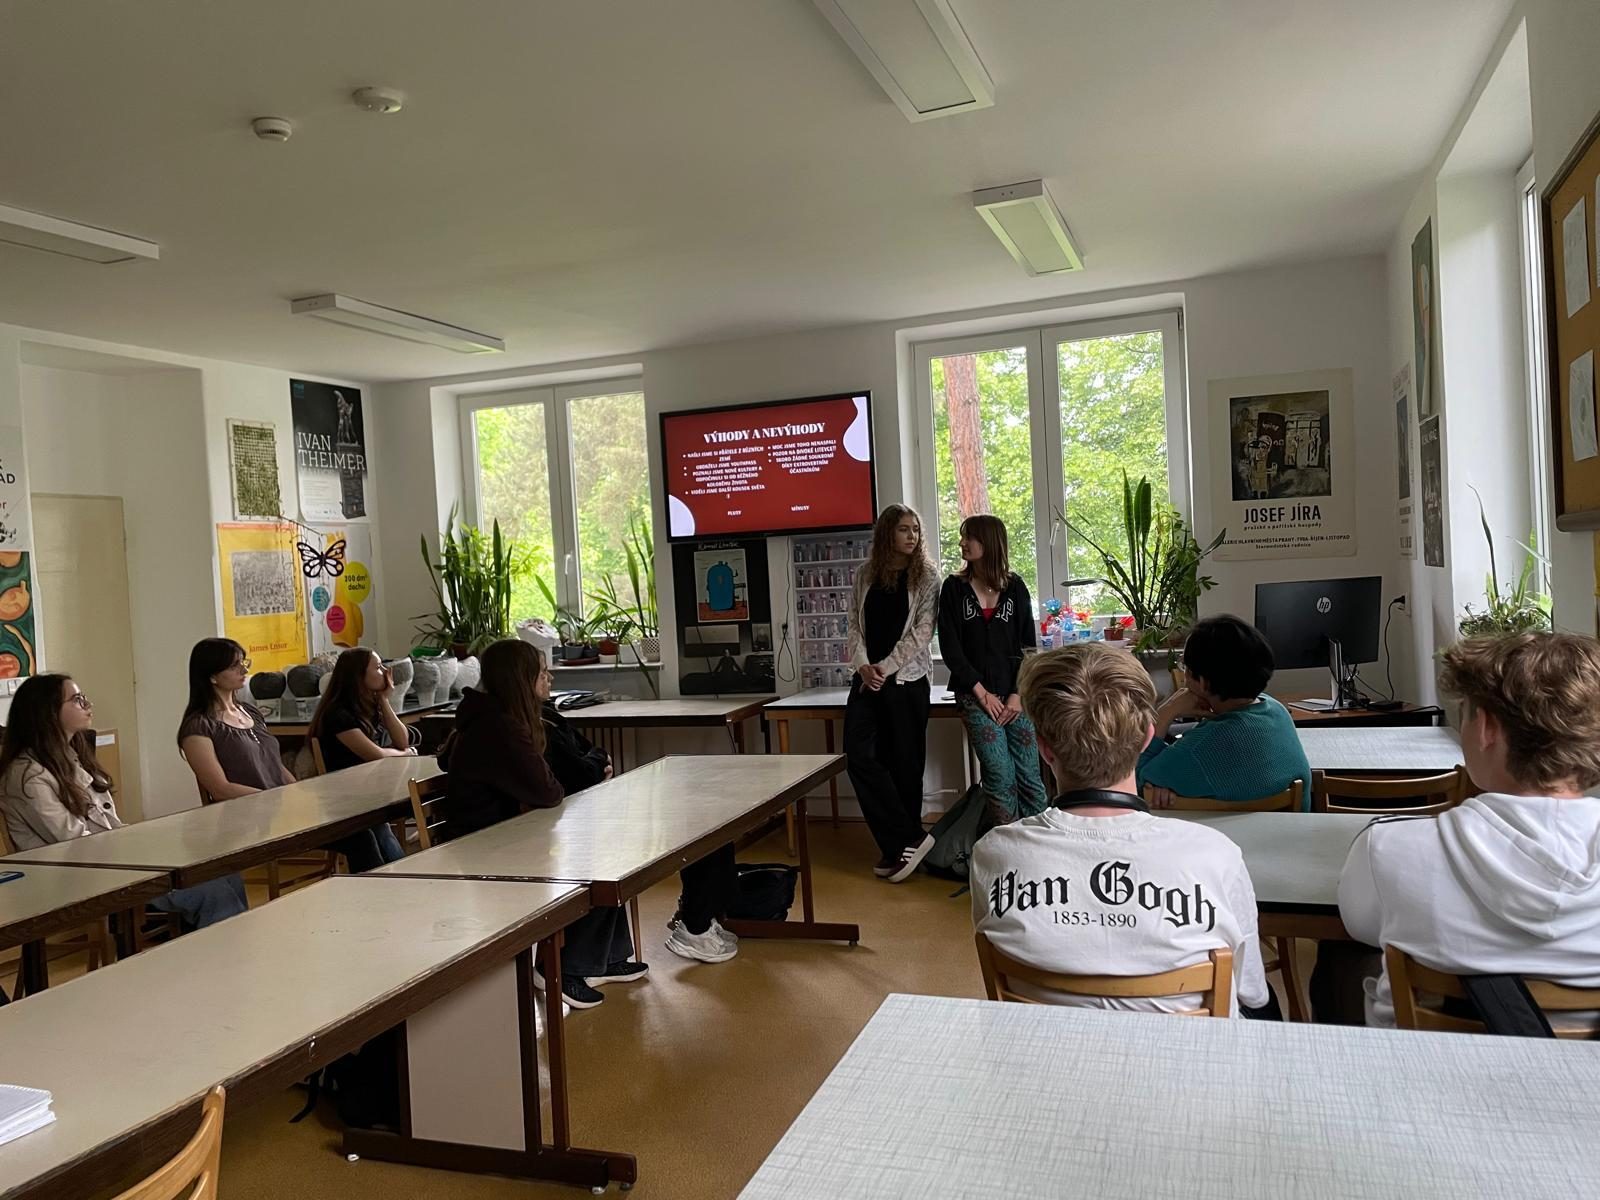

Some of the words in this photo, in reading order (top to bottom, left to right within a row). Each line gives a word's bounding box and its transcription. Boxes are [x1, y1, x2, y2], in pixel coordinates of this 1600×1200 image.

[298, 432, 330, 451] IVAN
[704, 430, 750, 444] VÝHODY
[752, 429, 760, 439] A
[762, 422, 825, 438] NEVÝHODY
[298, 450, 365, 470] THEIMER
[1244, 507, 1285, 523] JOSEF
[1291, 502, 1321, 521] JÍRA
[1316, 596, 1331, 614] hp
[990, 868, 1070, 919] Van
[1089, 860, 1217, 932] Gogh
[1053, 910, 1136, 928] 1853-1890
